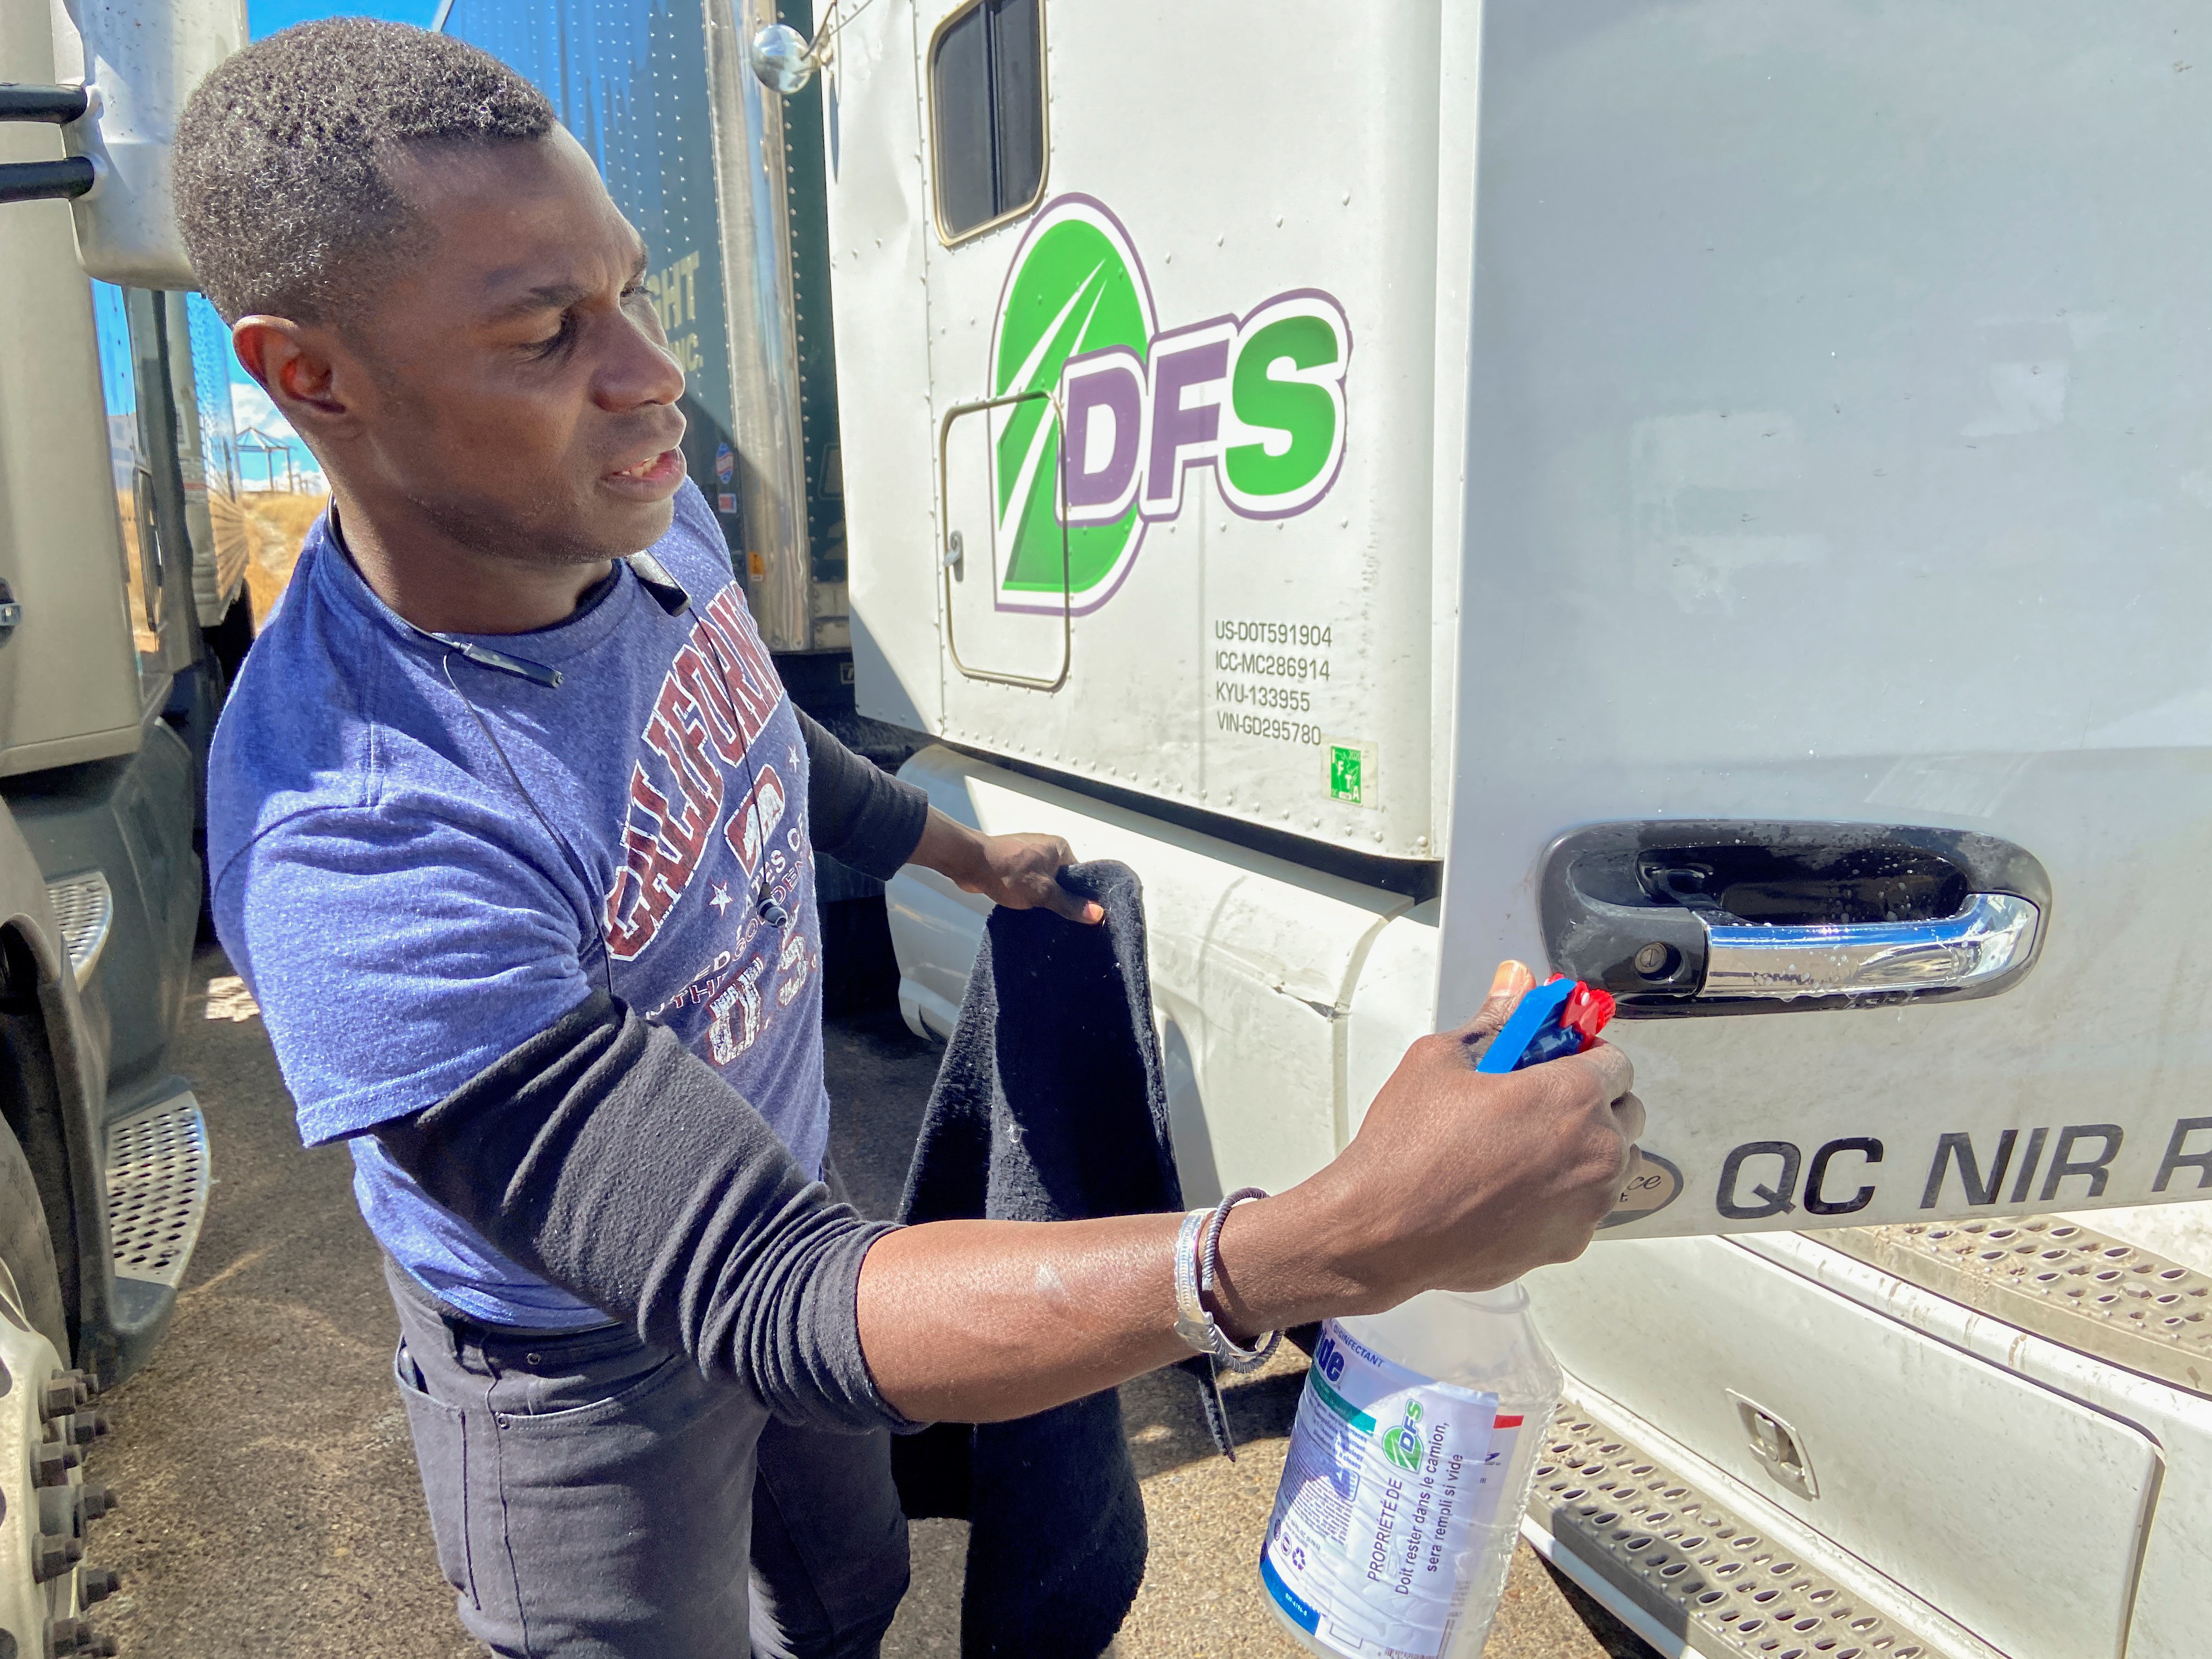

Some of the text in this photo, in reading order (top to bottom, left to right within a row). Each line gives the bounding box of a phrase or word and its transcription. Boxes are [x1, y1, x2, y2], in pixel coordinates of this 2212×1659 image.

[646, 250, 700, 330] GHT
[1060, 307, 1344, 516] DFS
[1215, 620, 1333, 647] US-DOT591904
[1215, 651, 1330, 681] ICC-MC286914
[1215, 681, 1311, 712] KYU-133955
[1217, 710, 1322, 747] VIN-GD295780
[1715, 1136, 1884, 1220] QC
[1919, 1123, 2124, 1210] NIR
[1398, 1399, 1423, 1453] DFS
[1367, 1477, 1403, 1582] PROPRIÉTÉ DE
[1395, 1422, 1450, 1595] Doit rester dans le camion,
[1427, 1454, 1464, 1573] sera rempli si vide
